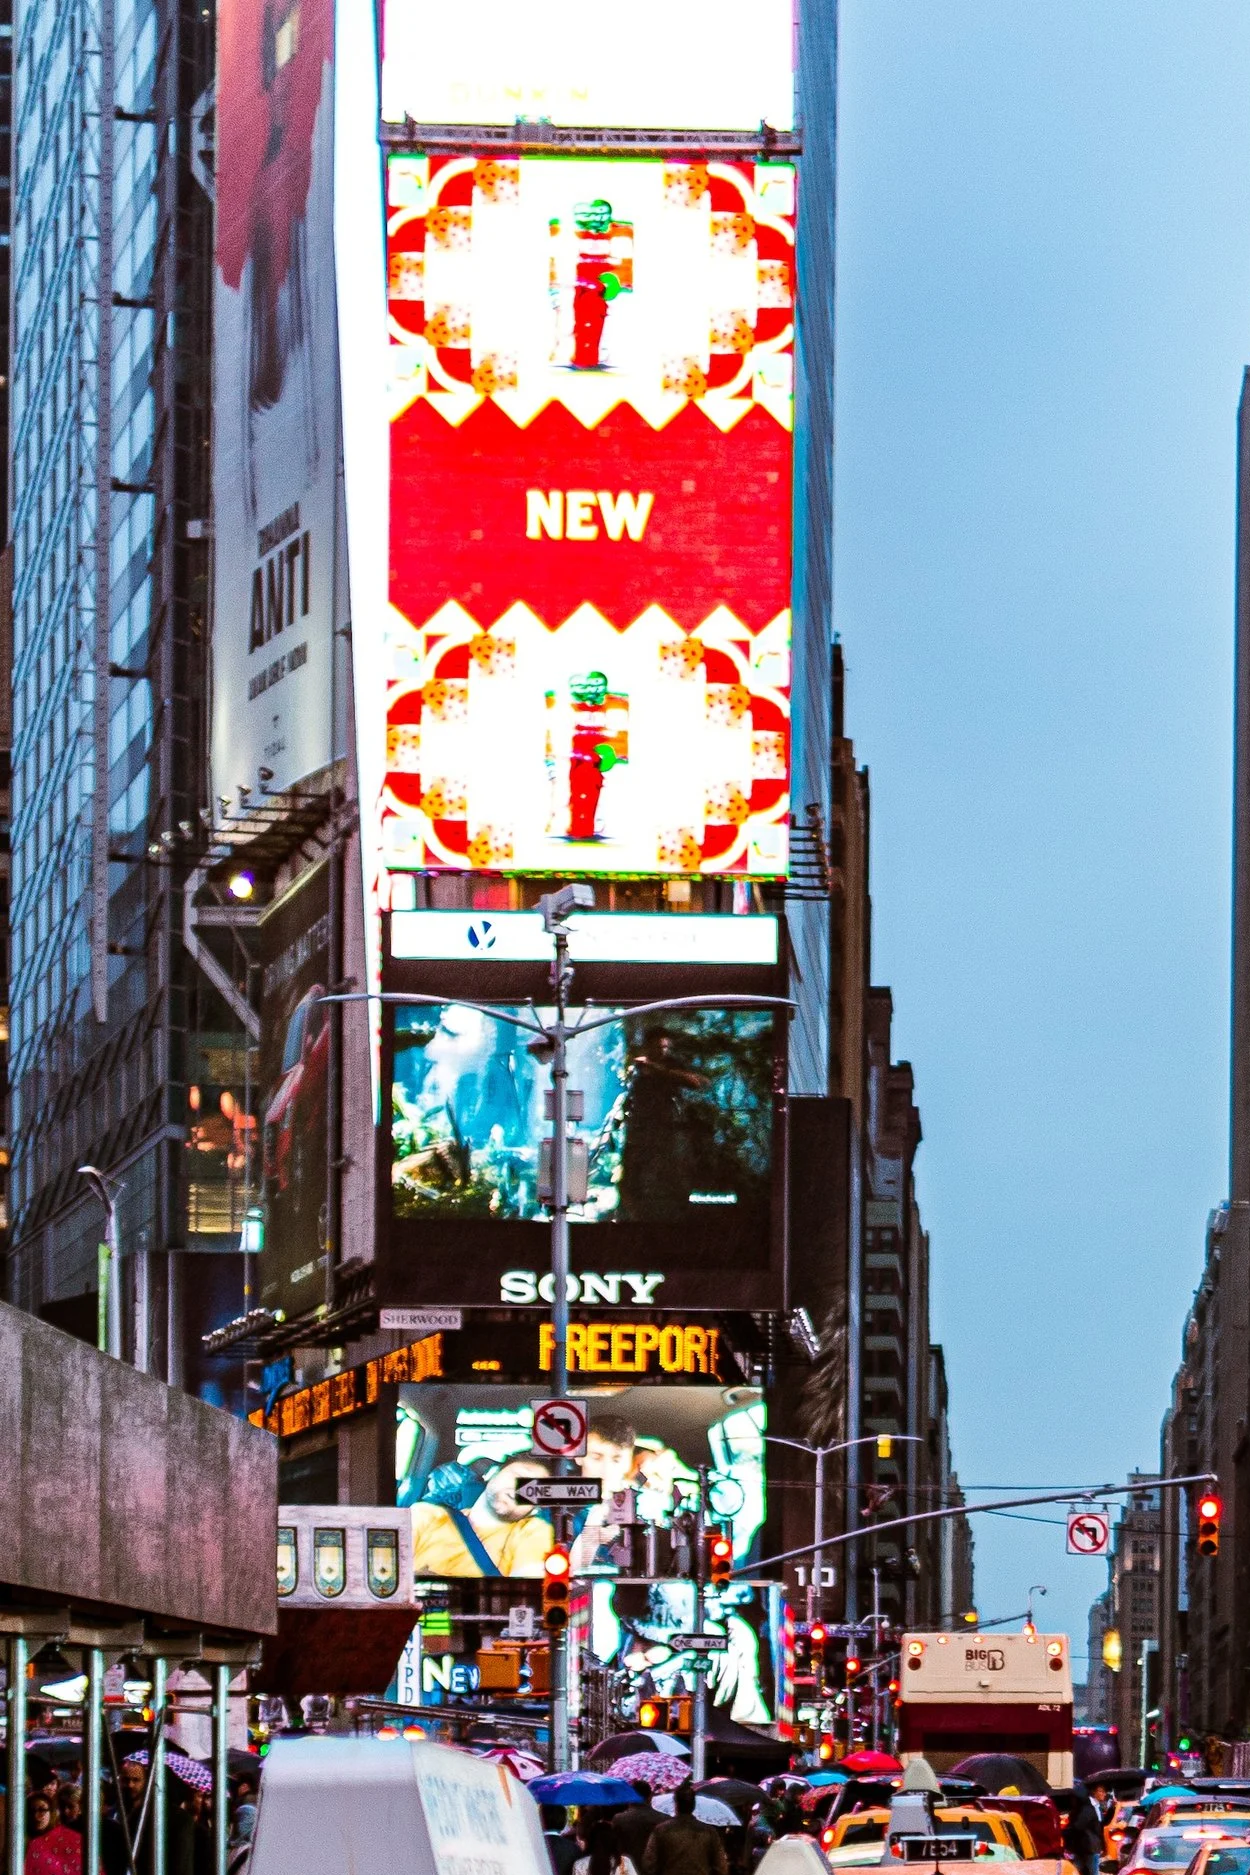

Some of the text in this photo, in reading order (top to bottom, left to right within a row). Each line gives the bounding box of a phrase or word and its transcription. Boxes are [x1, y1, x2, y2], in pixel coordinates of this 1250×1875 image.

[526, 489, 654, 541] NEW
[249, 530, 310, 655] ANTI
[501, 1270, 665, 1304] SONY
[382, 1313, 459, 1326] SHERWOOD
[539, 1322, 720, 1374] FREEPORT
[526, 1485, 595, 1498] ONE WAY
[674, 1638, 723, 1648] ONE WAY
[965, 1650, 987, 1660] BIG
[965, 1660, 987, 1671] BUS
